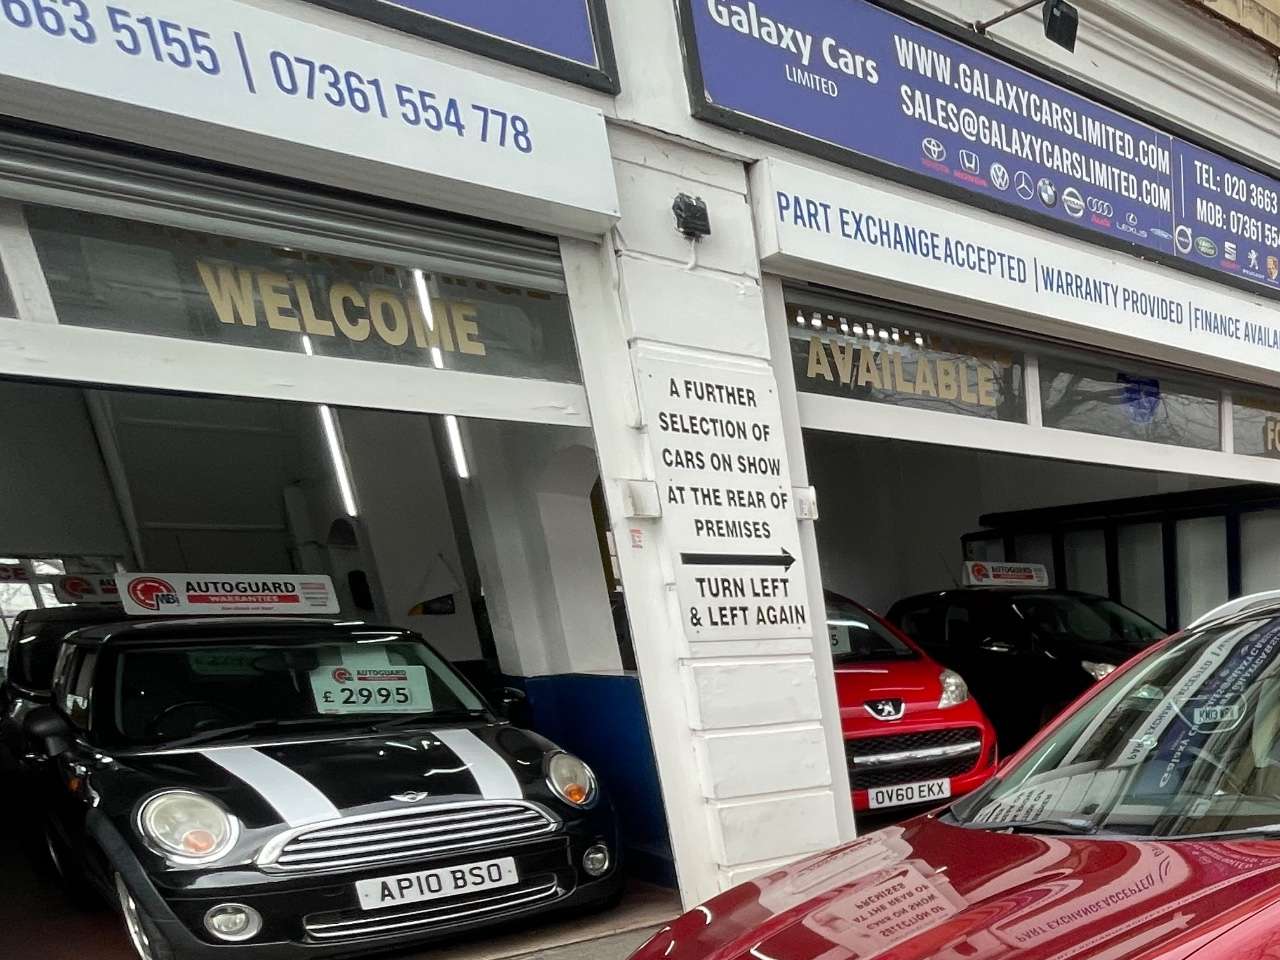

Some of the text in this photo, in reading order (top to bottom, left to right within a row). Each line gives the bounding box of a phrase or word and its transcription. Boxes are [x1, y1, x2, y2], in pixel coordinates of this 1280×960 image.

[707, 0, 879, 84] Galaxy Cars
[106, 6, 221, 77] 5155
[269, 50, 389, 119] 07361
[395, 83, 466, 137] 554
[471, 104, 534, 154] 778
[785, 64, 838, 97] LIMITED
[895, 35, 1170, 175] WWW.GALAXYCARSLIMITED.COM
[900, 84, 1171, 213] SALES@GALAXYCARSLIMITED.COM
[1194, 160, 1220, 192] TEL:
[1224, 173, 1247, 202] 020
[1250, 184, 1278, 214] 3663
[1196, 198, 1227, 230] MOB:
[1230, 211, 1261, 242] 07361
[777, 191, 831, 234] PART
[839, 207, 942, 262] EXCHANGE
[943, 237, 1027, 284] ACCEPTED
[1041, 264, 1119, 307] WARRANTY
[1122, 287, 1184, 325] PROVIDED
[1194, 307, 1241, 341] FINANCE
[196, 258, 487, 357] WELCOME
[807, 336, 997, 406] AVAILABLE
[669, 377, 758, 408] A FURTHER
[658, 412, 771, 442] SELECTION OF
[662, 448, 781, 477] CARS ON SHOW
[667, 485, 788, 511] AT THE REAR OF
[694, 518, 771, 540] PREMISES
[185, 581, 296, 594] AUTOGUARD
[695, 577, 789, 598] TURN LEFT
[690, 605, 807, 627] & LEFT AGAIN
[340, 687, 409, 704] 2995
[876, 781, 945, 805] OV60 EKX
[380, 863, 503, 902] AP10 BSO
